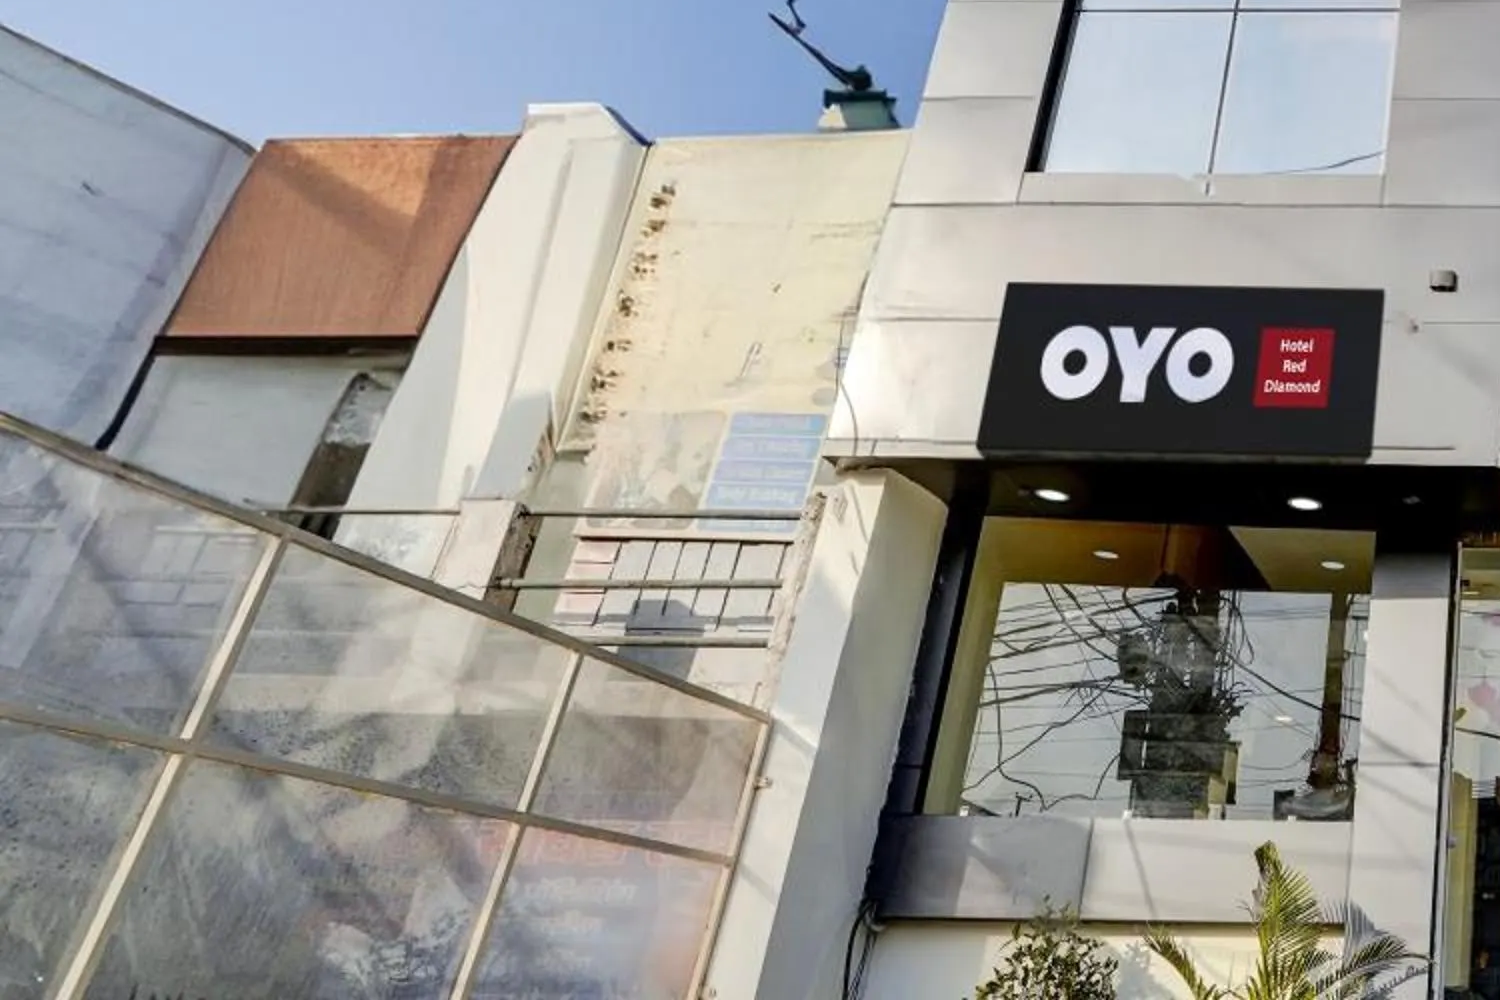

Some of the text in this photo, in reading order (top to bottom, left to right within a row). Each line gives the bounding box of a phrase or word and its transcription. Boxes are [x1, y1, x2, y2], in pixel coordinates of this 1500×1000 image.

[1280, 337, 1315, 353] Hotel
[1040, 325, 1235, 403] OYO
[1282, 358, 1307, 373] Red
[1263, 379, 1321, 393] Diamond
